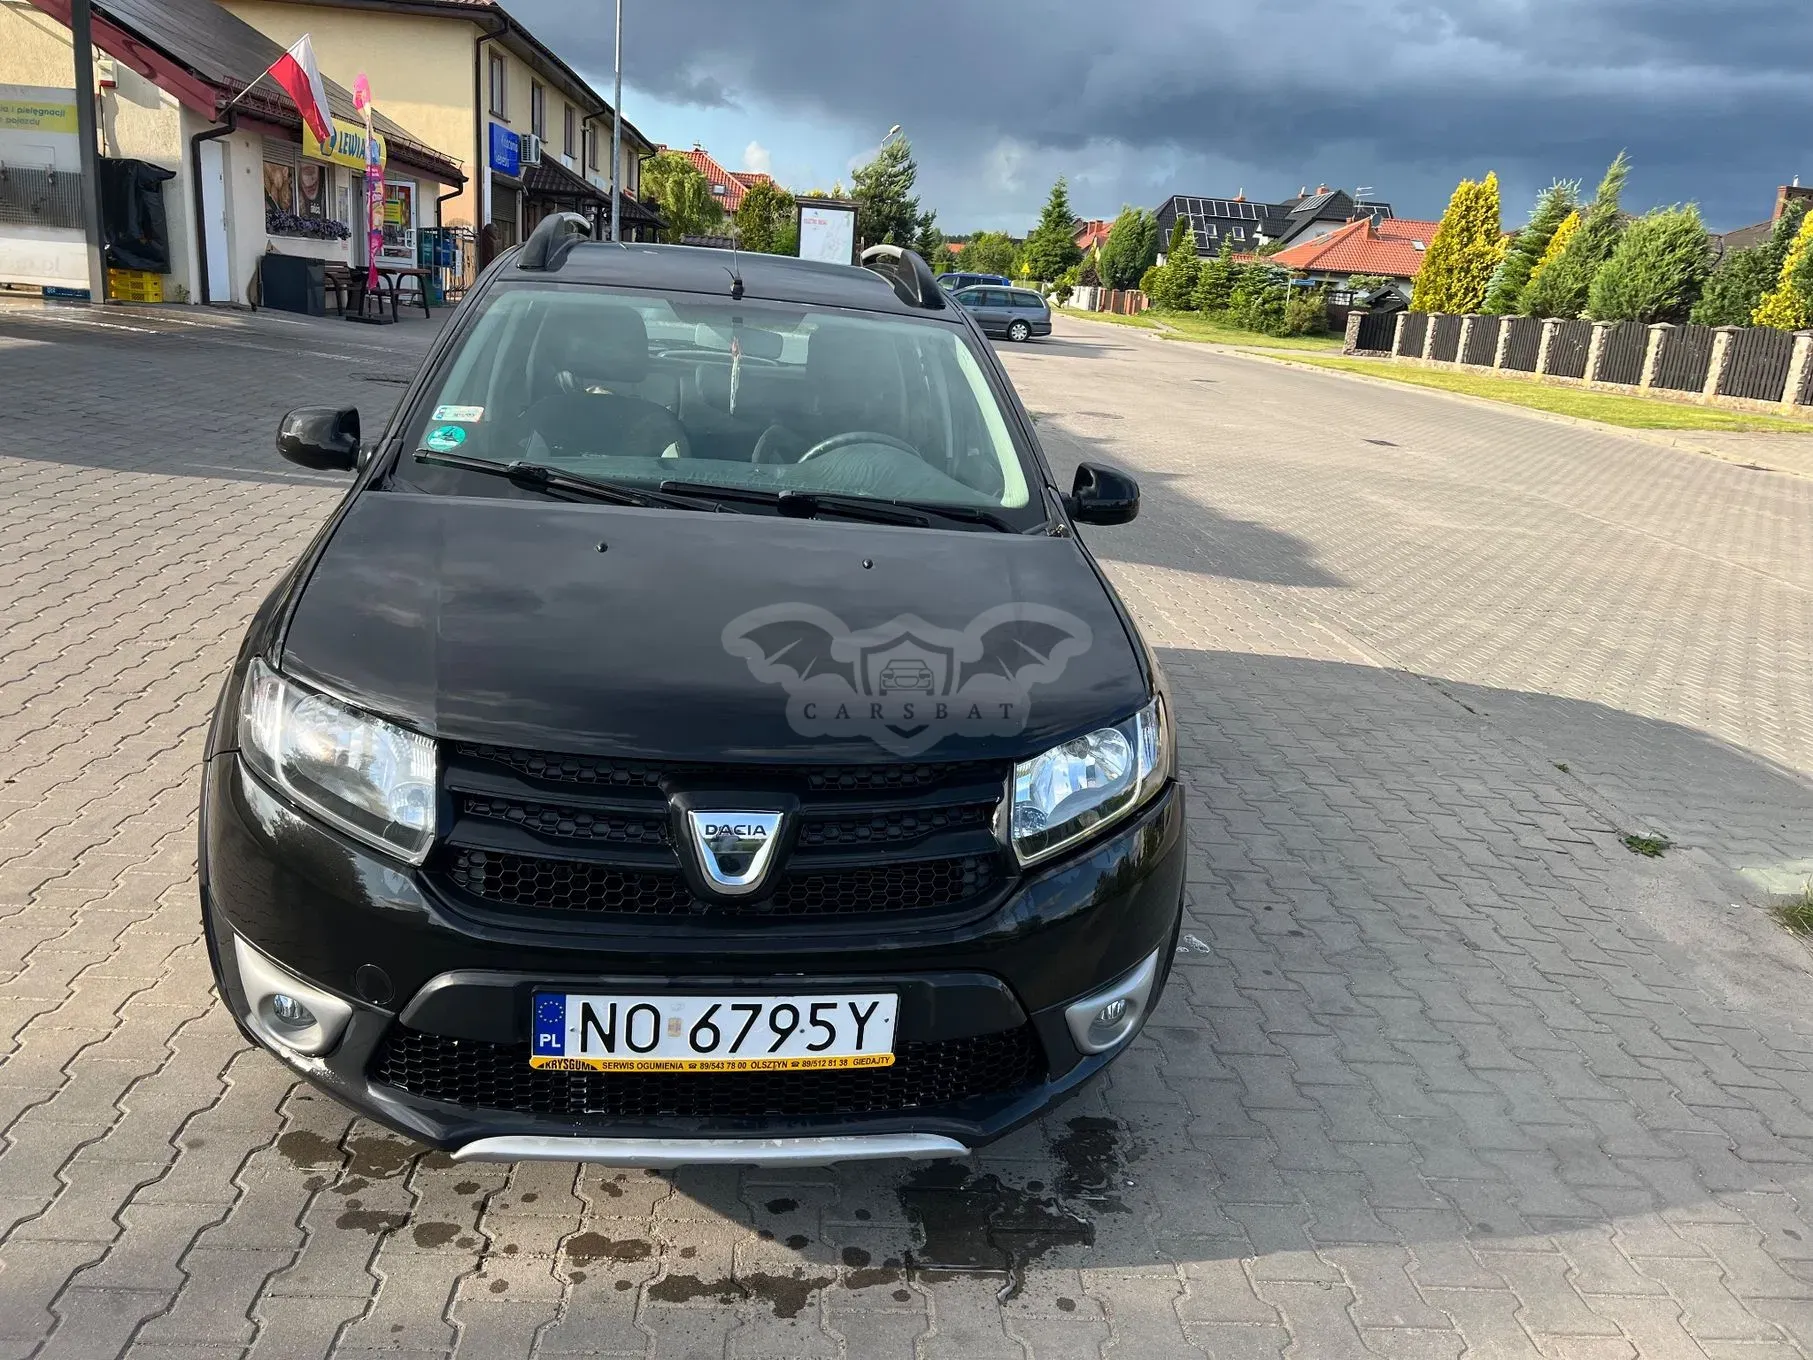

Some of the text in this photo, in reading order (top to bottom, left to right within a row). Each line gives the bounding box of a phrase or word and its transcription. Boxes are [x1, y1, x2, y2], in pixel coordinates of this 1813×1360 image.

[17, 106, 66, 117] pielęgnacji
[705, 824, 767, 836] DACIA
[581, 1001, 880, 1054] NO 6795Y
[540, 1033, 561, 1047] PL
[545, 1059, 590, 1071] KRYSGUM
[602, 1056, 890, 1070] SERWIS OGUMIENIA 89/543 78 00 OLSZTYN 89/512 81 38 GIEDAJTY
